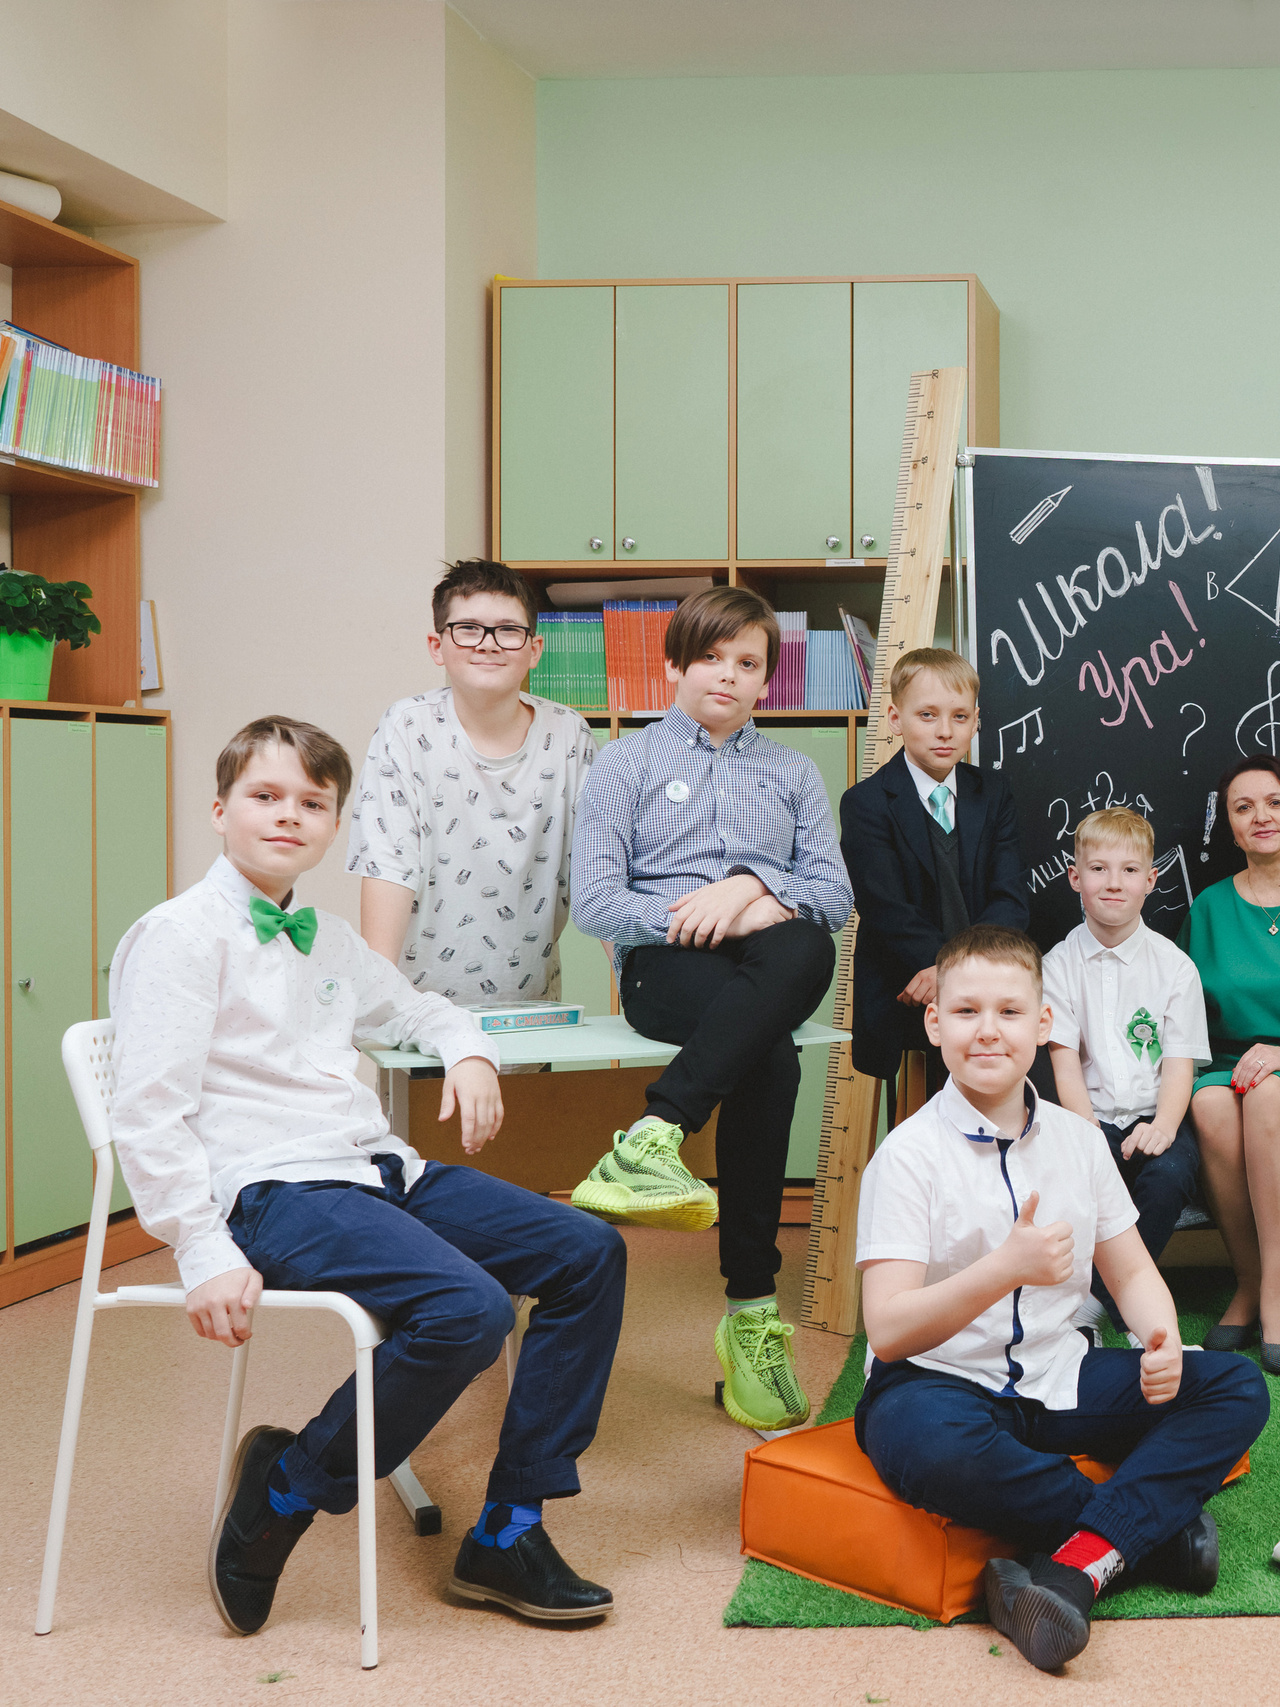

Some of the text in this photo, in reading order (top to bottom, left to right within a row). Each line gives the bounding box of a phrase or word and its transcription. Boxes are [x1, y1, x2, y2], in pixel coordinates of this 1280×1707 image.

[991, 466, 1222, 686] Школа!
[1079, 581, 1206, 729] Ура!
[832, 1225, 839, 1233] 2
